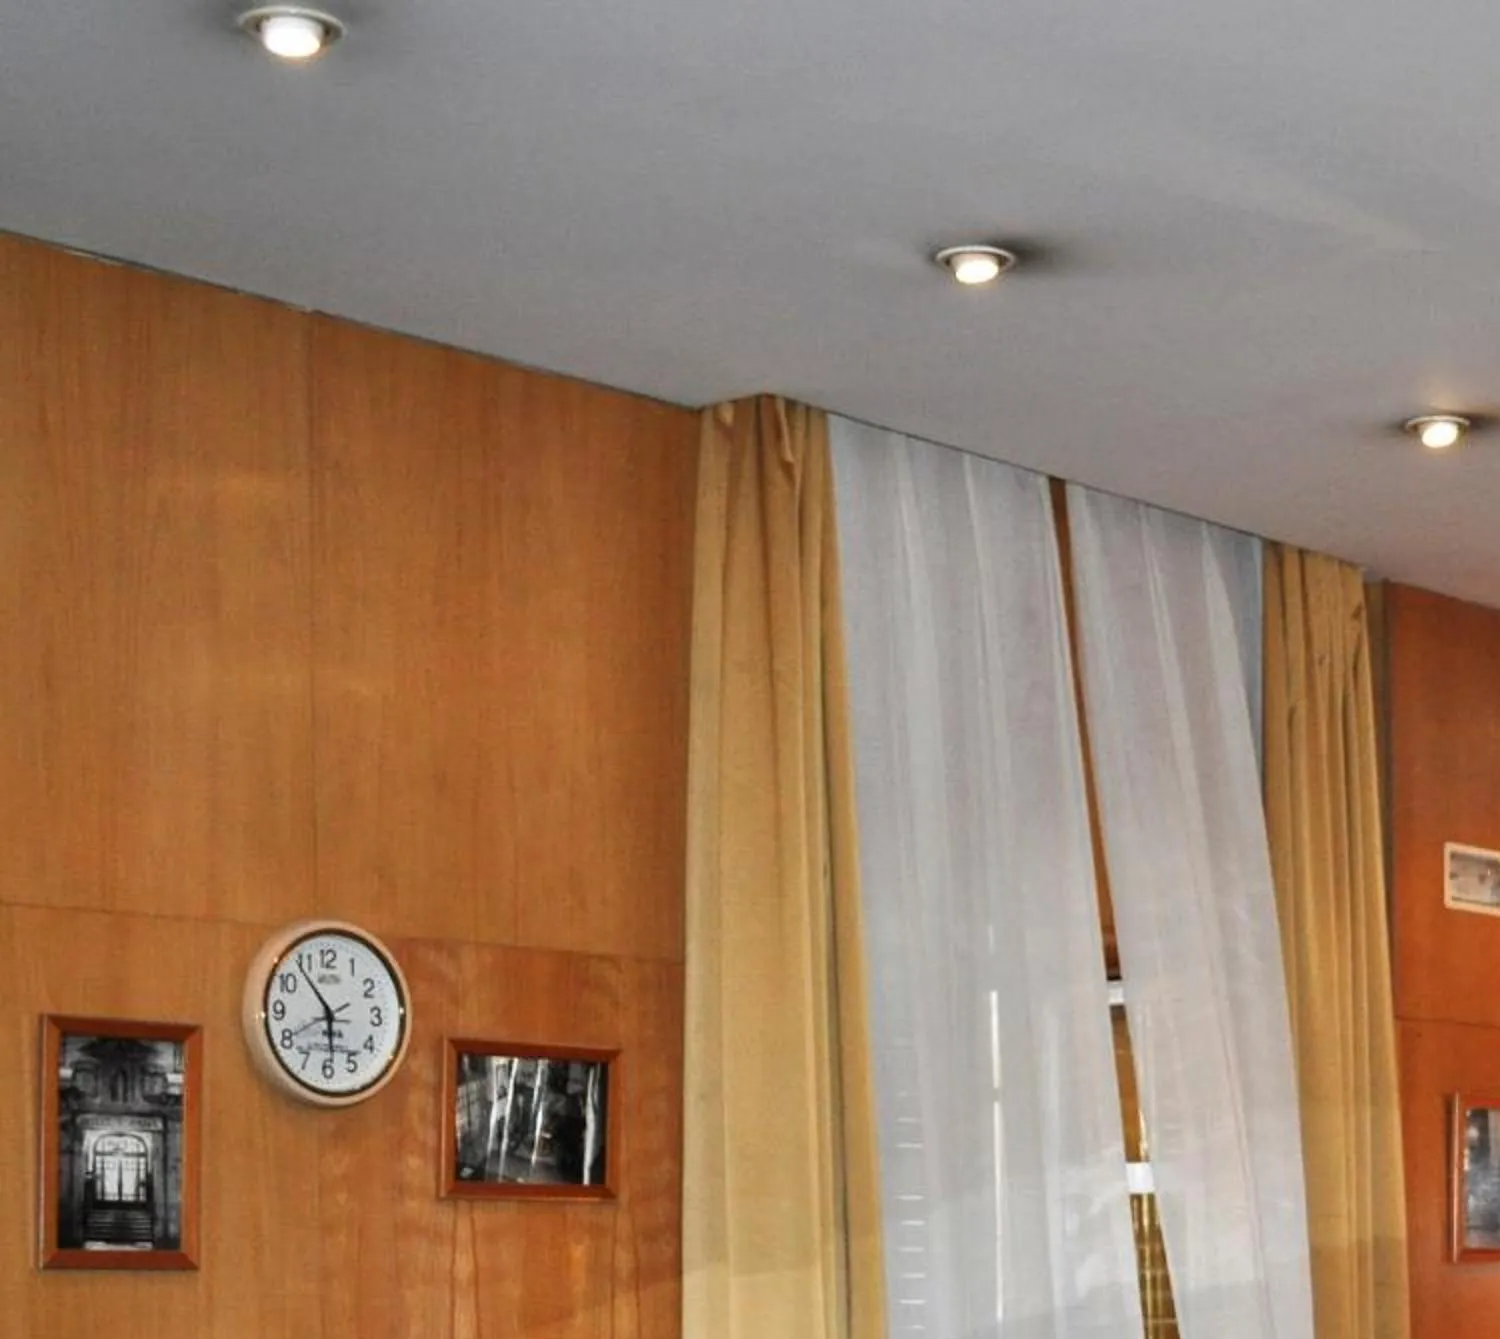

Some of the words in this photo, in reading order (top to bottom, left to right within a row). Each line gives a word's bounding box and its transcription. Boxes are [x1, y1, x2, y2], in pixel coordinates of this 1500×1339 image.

[319, 949, 337, 969] 12
[349, 957, 356, 977] 1
[278, 972, 297, 994] 10
[362, 978, 376, 999] 2
[272, 1000, 286, 1021] 9
[370, 1006, 383, 1027] 3
[280, 1028, 294, 1049] 8
[363, 1035, 375, 1053] 4
[297, 1051, 311, 1070] 7
[321, 1058, 335, 1079] 6
[345, 1052, 358, 1073] 5
